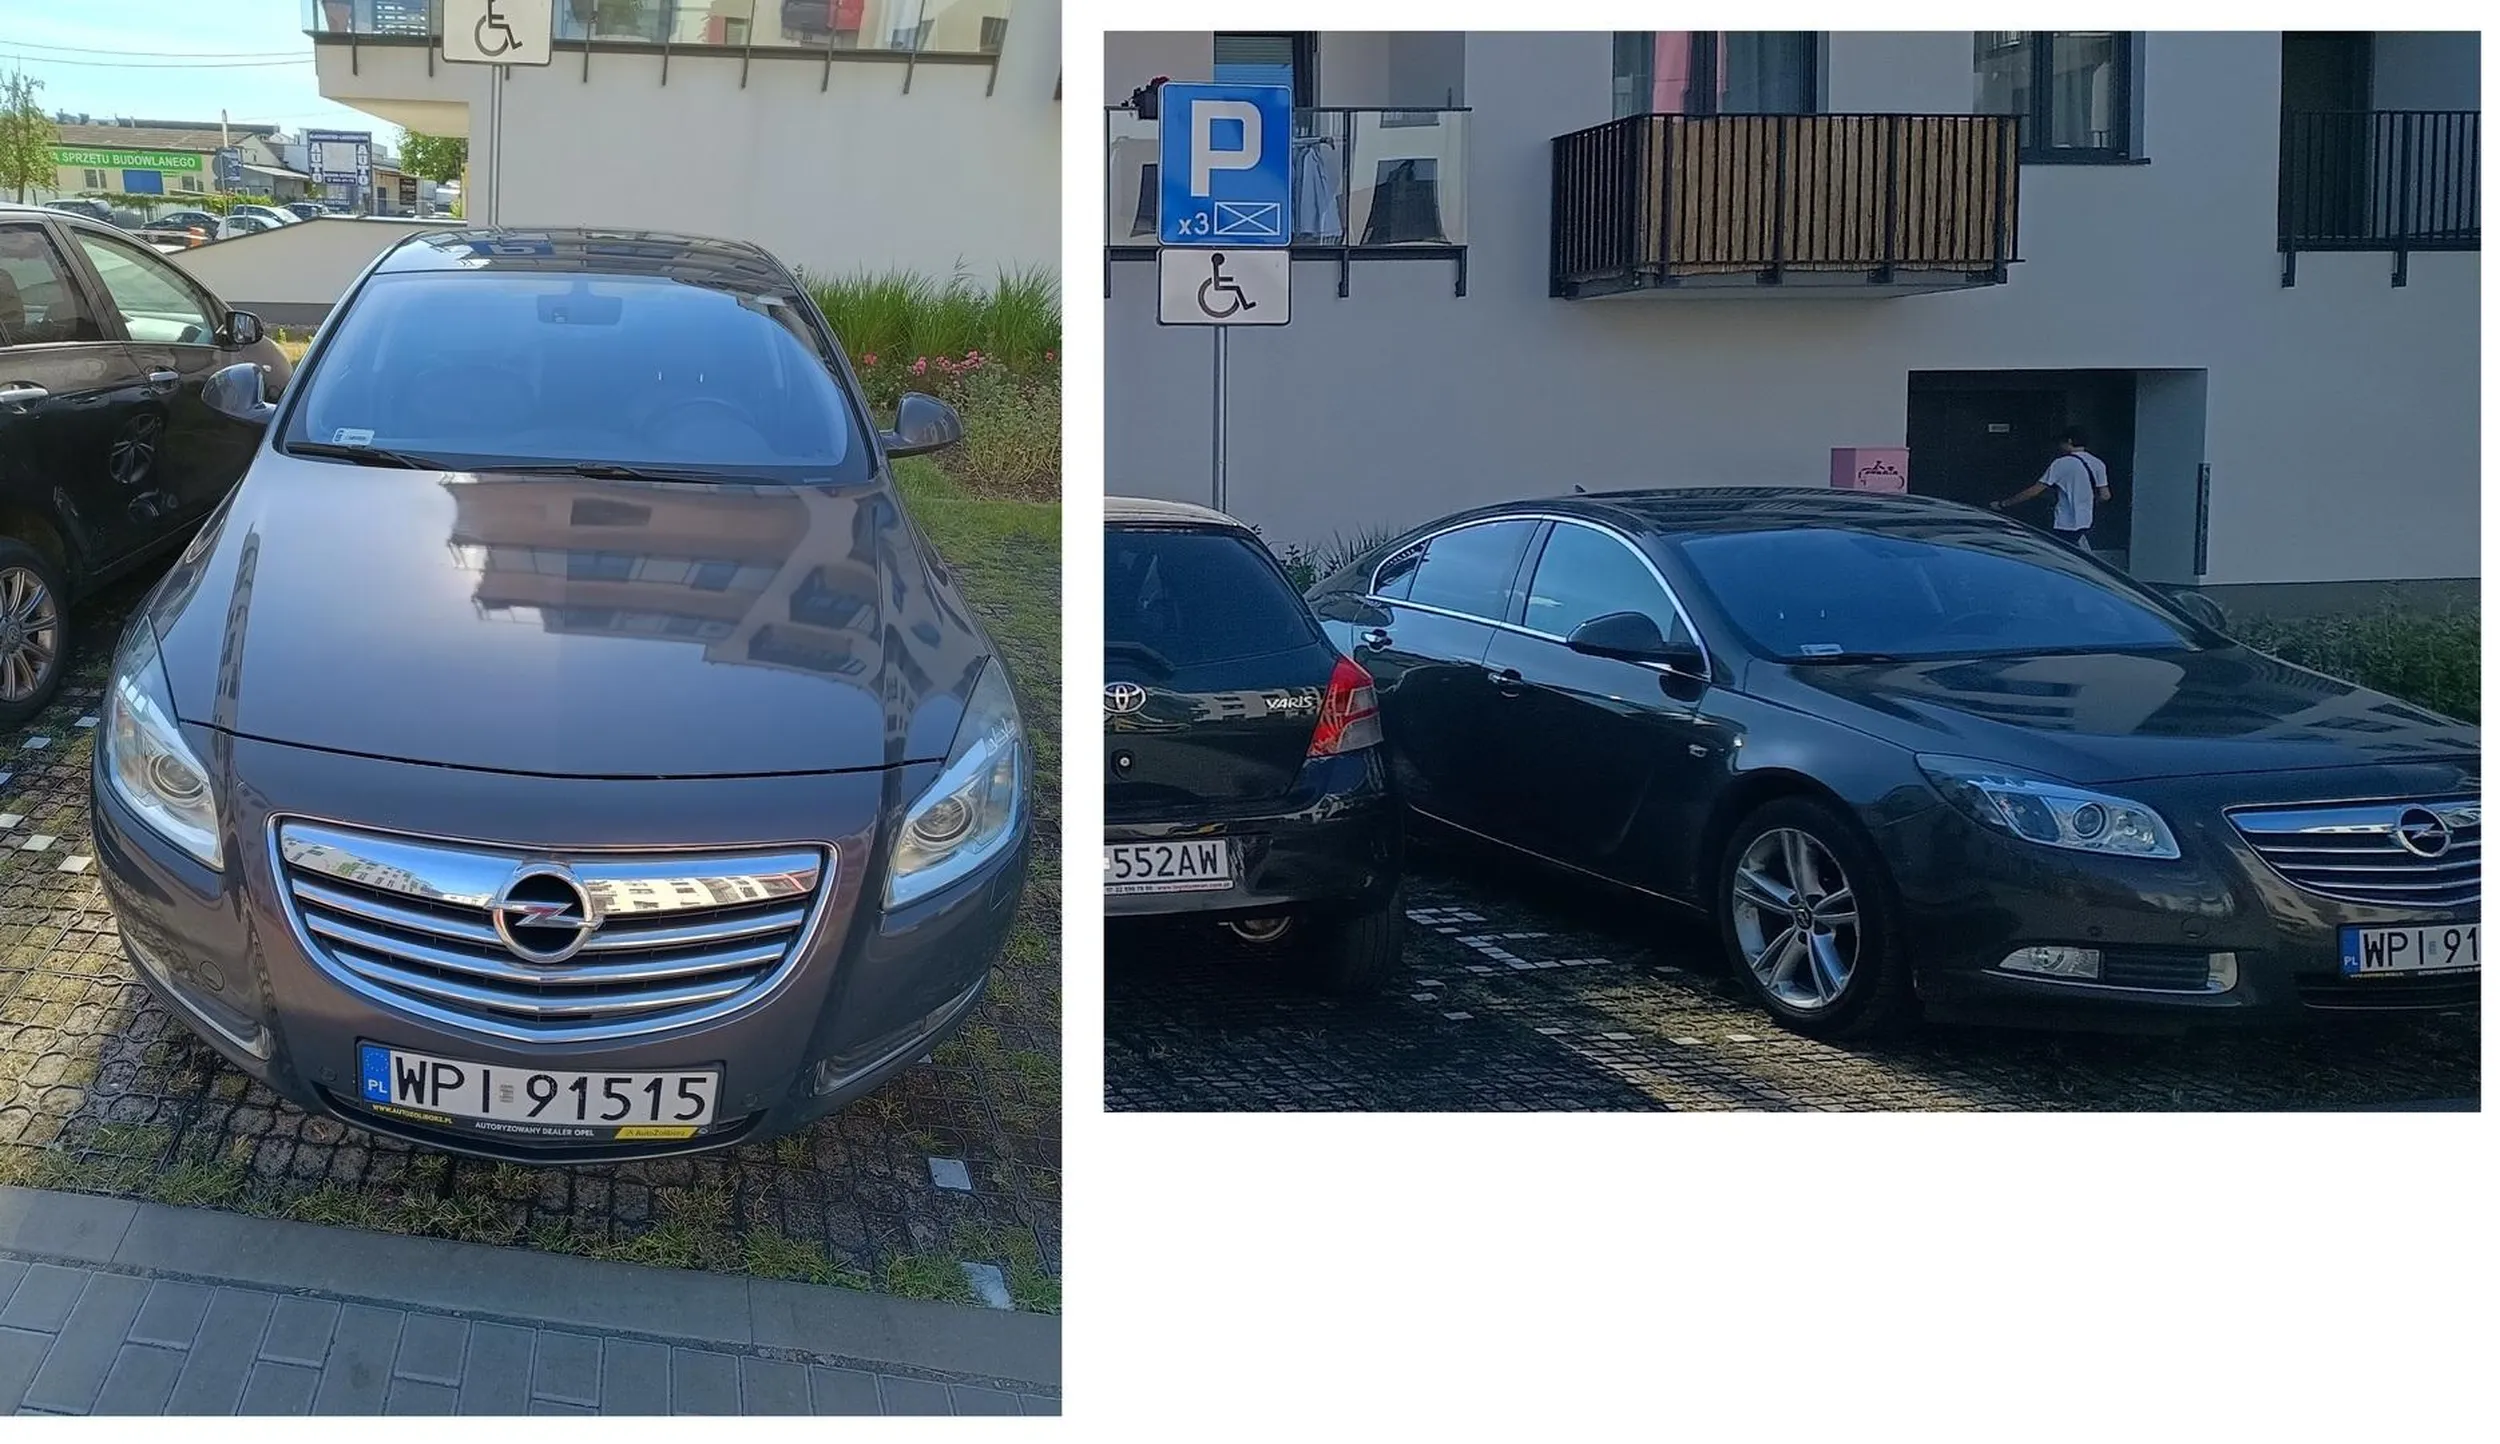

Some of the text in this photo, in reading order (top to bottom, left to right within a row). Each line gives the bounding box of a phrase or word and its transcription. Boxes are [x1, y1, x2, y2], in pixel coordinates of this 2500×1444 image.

[1191, 100, 1262, 197] P
[62, 152, 109, 165] SPRZĘTU
[113, 154, 196, 168] BUDOWLANEGO
[1178, 212, 1210, 236] x3
[1265, 696, 1313, 709] YARIS
[1113, 844, 1217, 878] 552AW
[2344, 955, 2358, 966] PL
[368, 1079, 388, 1094] PL
[526, 1074, 707, 1121] 91515
[475, 1121, 595, 1137] AUTORYZOWANY DEALER OPEL
